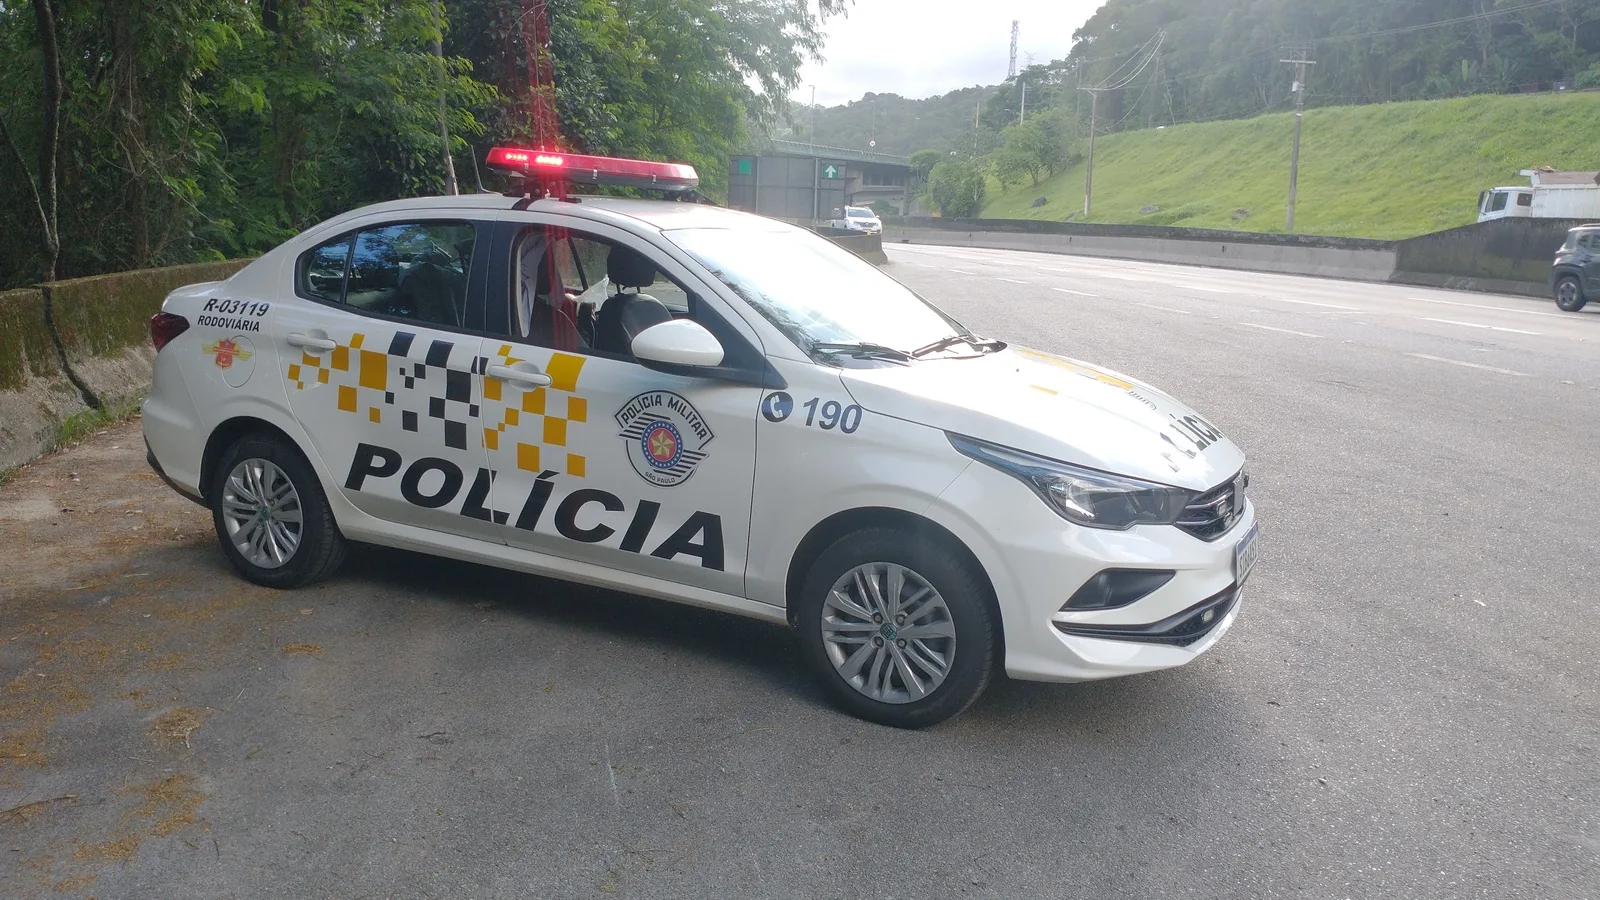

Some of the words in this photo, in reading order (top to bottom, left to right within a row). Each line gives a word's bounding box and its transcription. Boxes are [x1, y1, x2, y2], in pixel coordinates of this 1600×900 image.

[197, 314, 260, 333] RODOVIÁRIA
[203, 298, 270, 317] R-03119
[620, 394, 663, 425] POLÍCIA
[667, 396, 708, 441] MILITAR
[802, 397, 863, 434] 190
[344, 442, 725, 572] POLÍCIA
